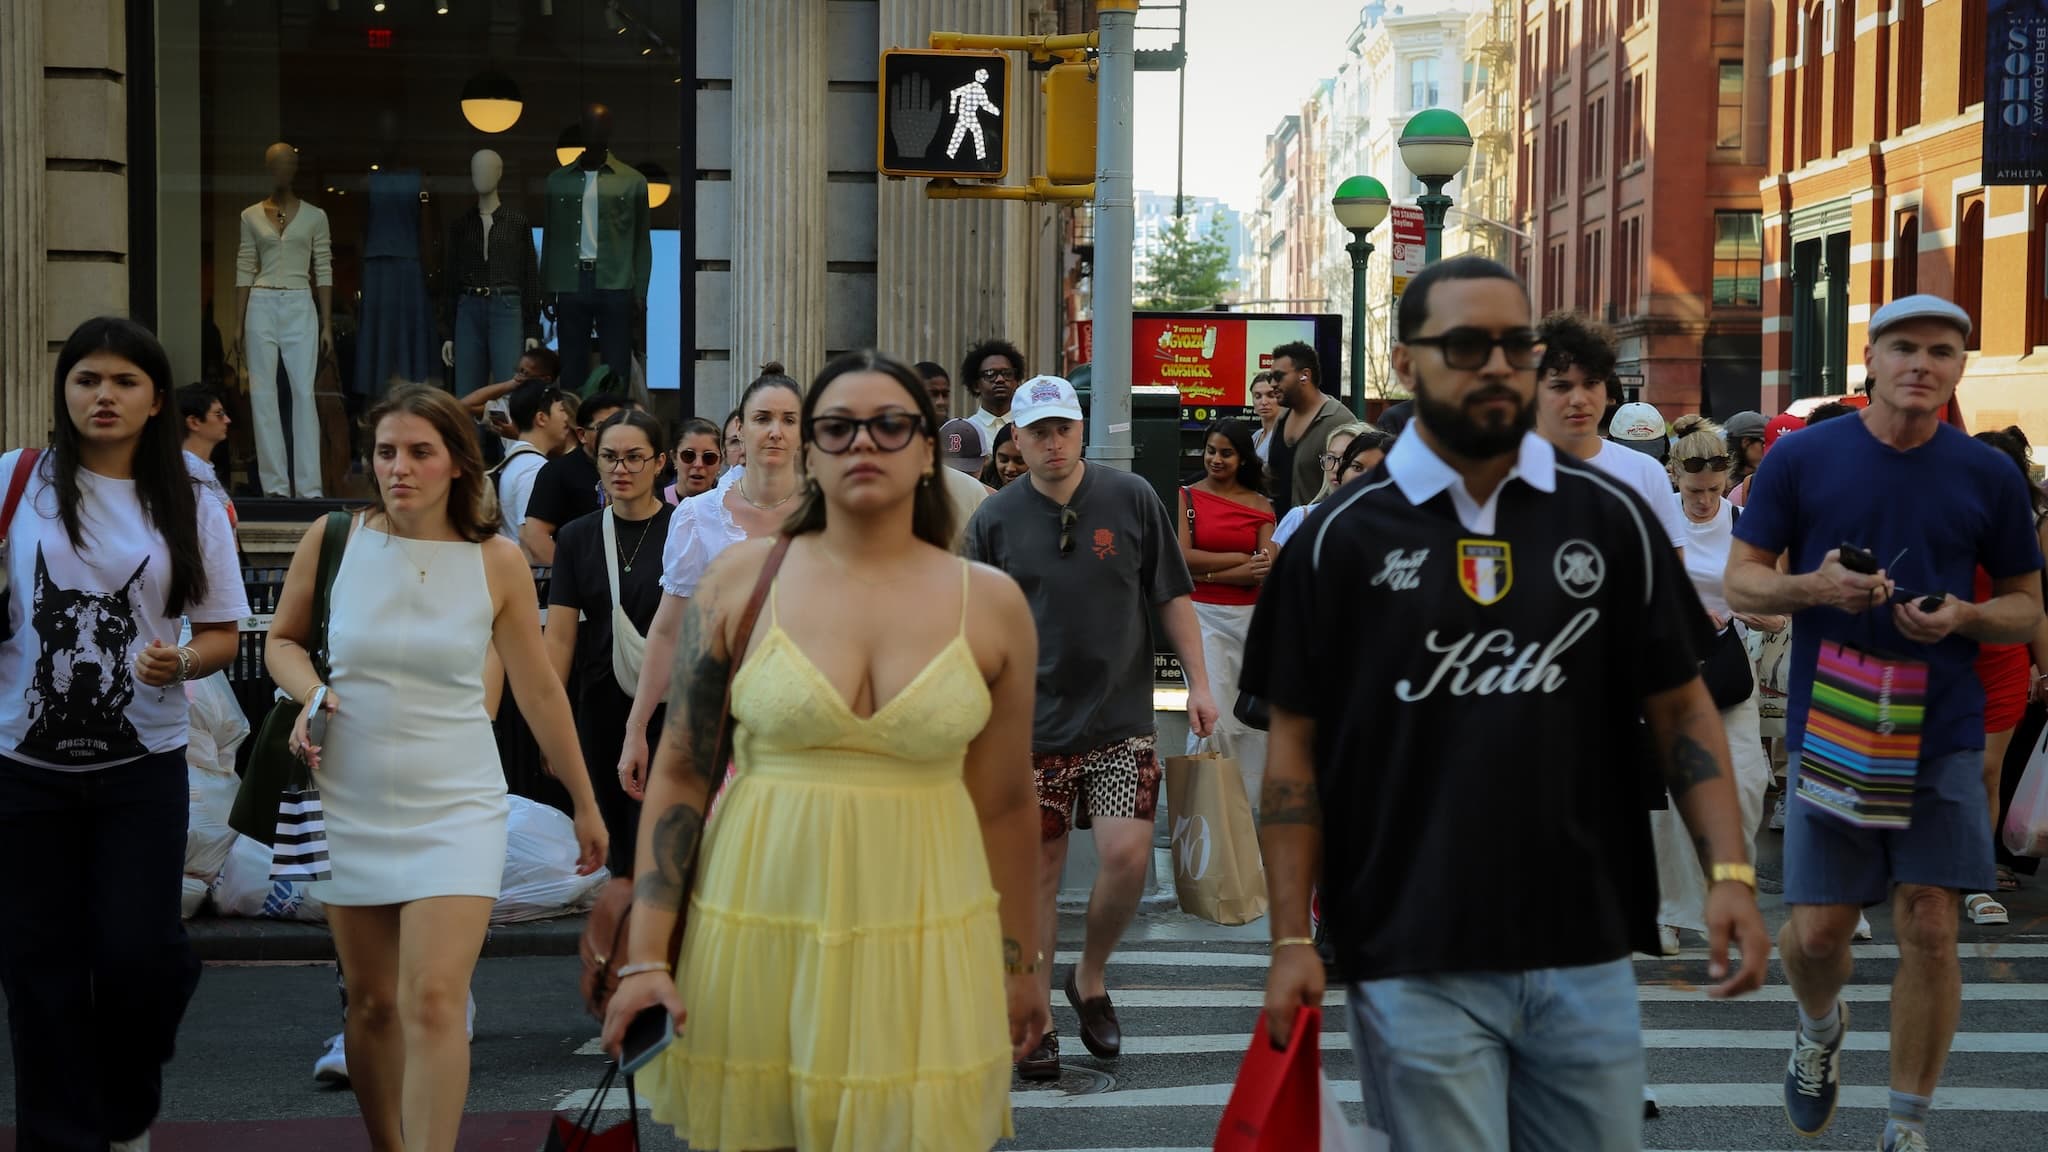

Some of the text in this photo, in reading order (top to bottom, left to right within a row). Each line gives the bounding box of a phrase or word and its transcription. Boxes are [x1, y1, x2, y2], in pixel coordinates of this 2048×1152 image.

[2032, 26, 2047, 126] BROADWAY
[1997, 169, 2043, 180] ATHLETA
[1170, 334, 1205, 349] GYOZA
[1210, 409, 1217, 417] 9
[948, 434, 962, 453] B
[1371, 548, 1431, 587] Just
[1395, 608, 1599, 702] Kith
[1161, 669, 1182, 678] see
